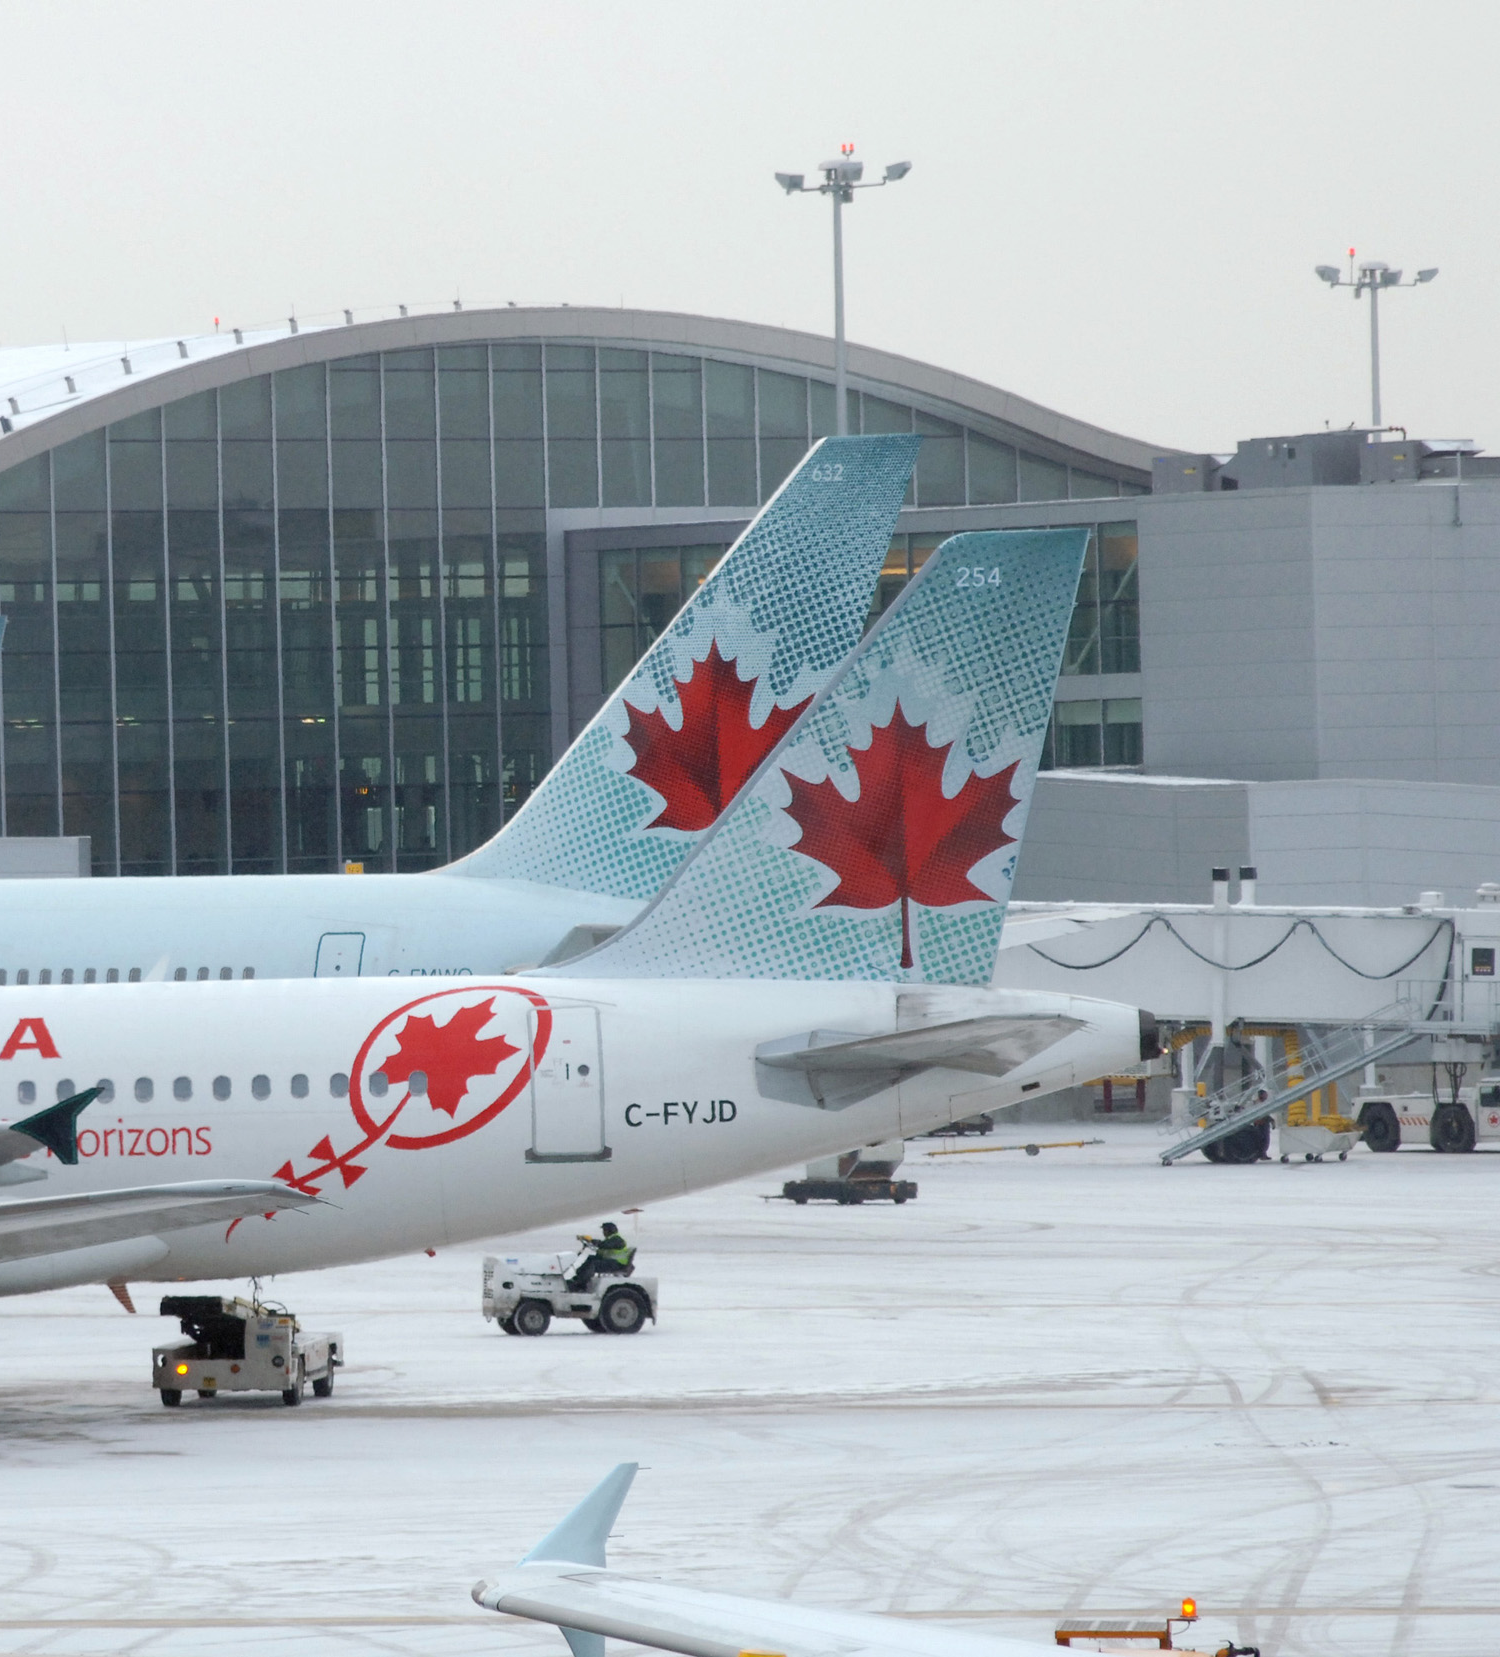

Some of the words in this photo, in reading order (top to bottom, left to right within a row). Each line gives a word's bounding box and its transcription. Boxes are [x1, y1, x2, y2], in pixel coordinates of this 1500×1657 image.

[812, 463, 844, 481] 632
[956, 566, 1002, 587] 254
[624, 1100, 737, 1127] C-FYJD
[47, 1118, 212, 1158] orizons
